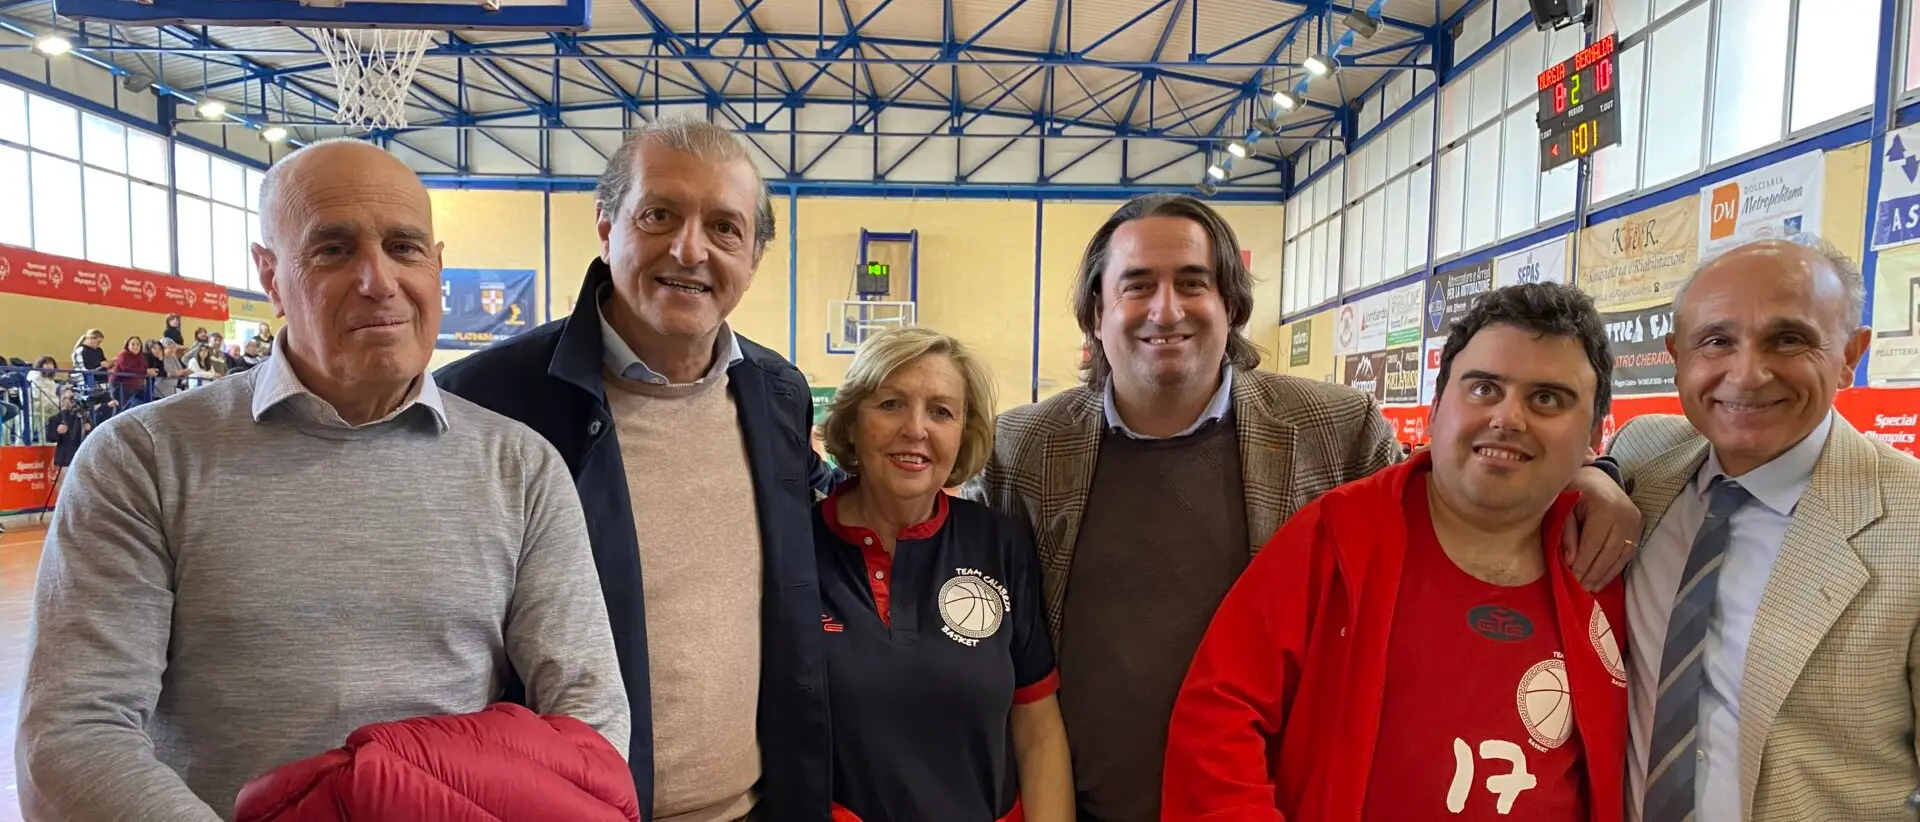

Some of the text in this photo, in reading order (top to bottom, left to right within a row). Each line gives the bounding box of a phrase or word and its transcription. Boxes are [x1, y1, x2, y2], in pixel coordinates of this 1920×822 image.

[1596, 59, 1610, 92] 10
[1555, 82, 1565, 113] 8
[1571, 74, 1580, 105] 2
[1568, 105, 1584, 118] PERIOD
[1600, 100, 1614, 113] T.OUT
[1572, 120, 1597, 156] 1:01
[1744, 176, 1784, 195] DOLCIARIA
[1713, 199, 1736, 224] DM
[1741, 184, 1803, 215] Metropolitana
[1517, 262, 1540, 284] SEPAS
[1605, 315, 1644, 343] TTICA
[1875, 413, 1918, 428] Special
[956, 568, 1011, 612] TEAM CALABRIA
[941, 625, 980, 647] BASKET
[1552, 651, 1564, 659] TEA
[1527, 737, 1549, 754] BASKET
[1446, 737, 1537, 815] 17
